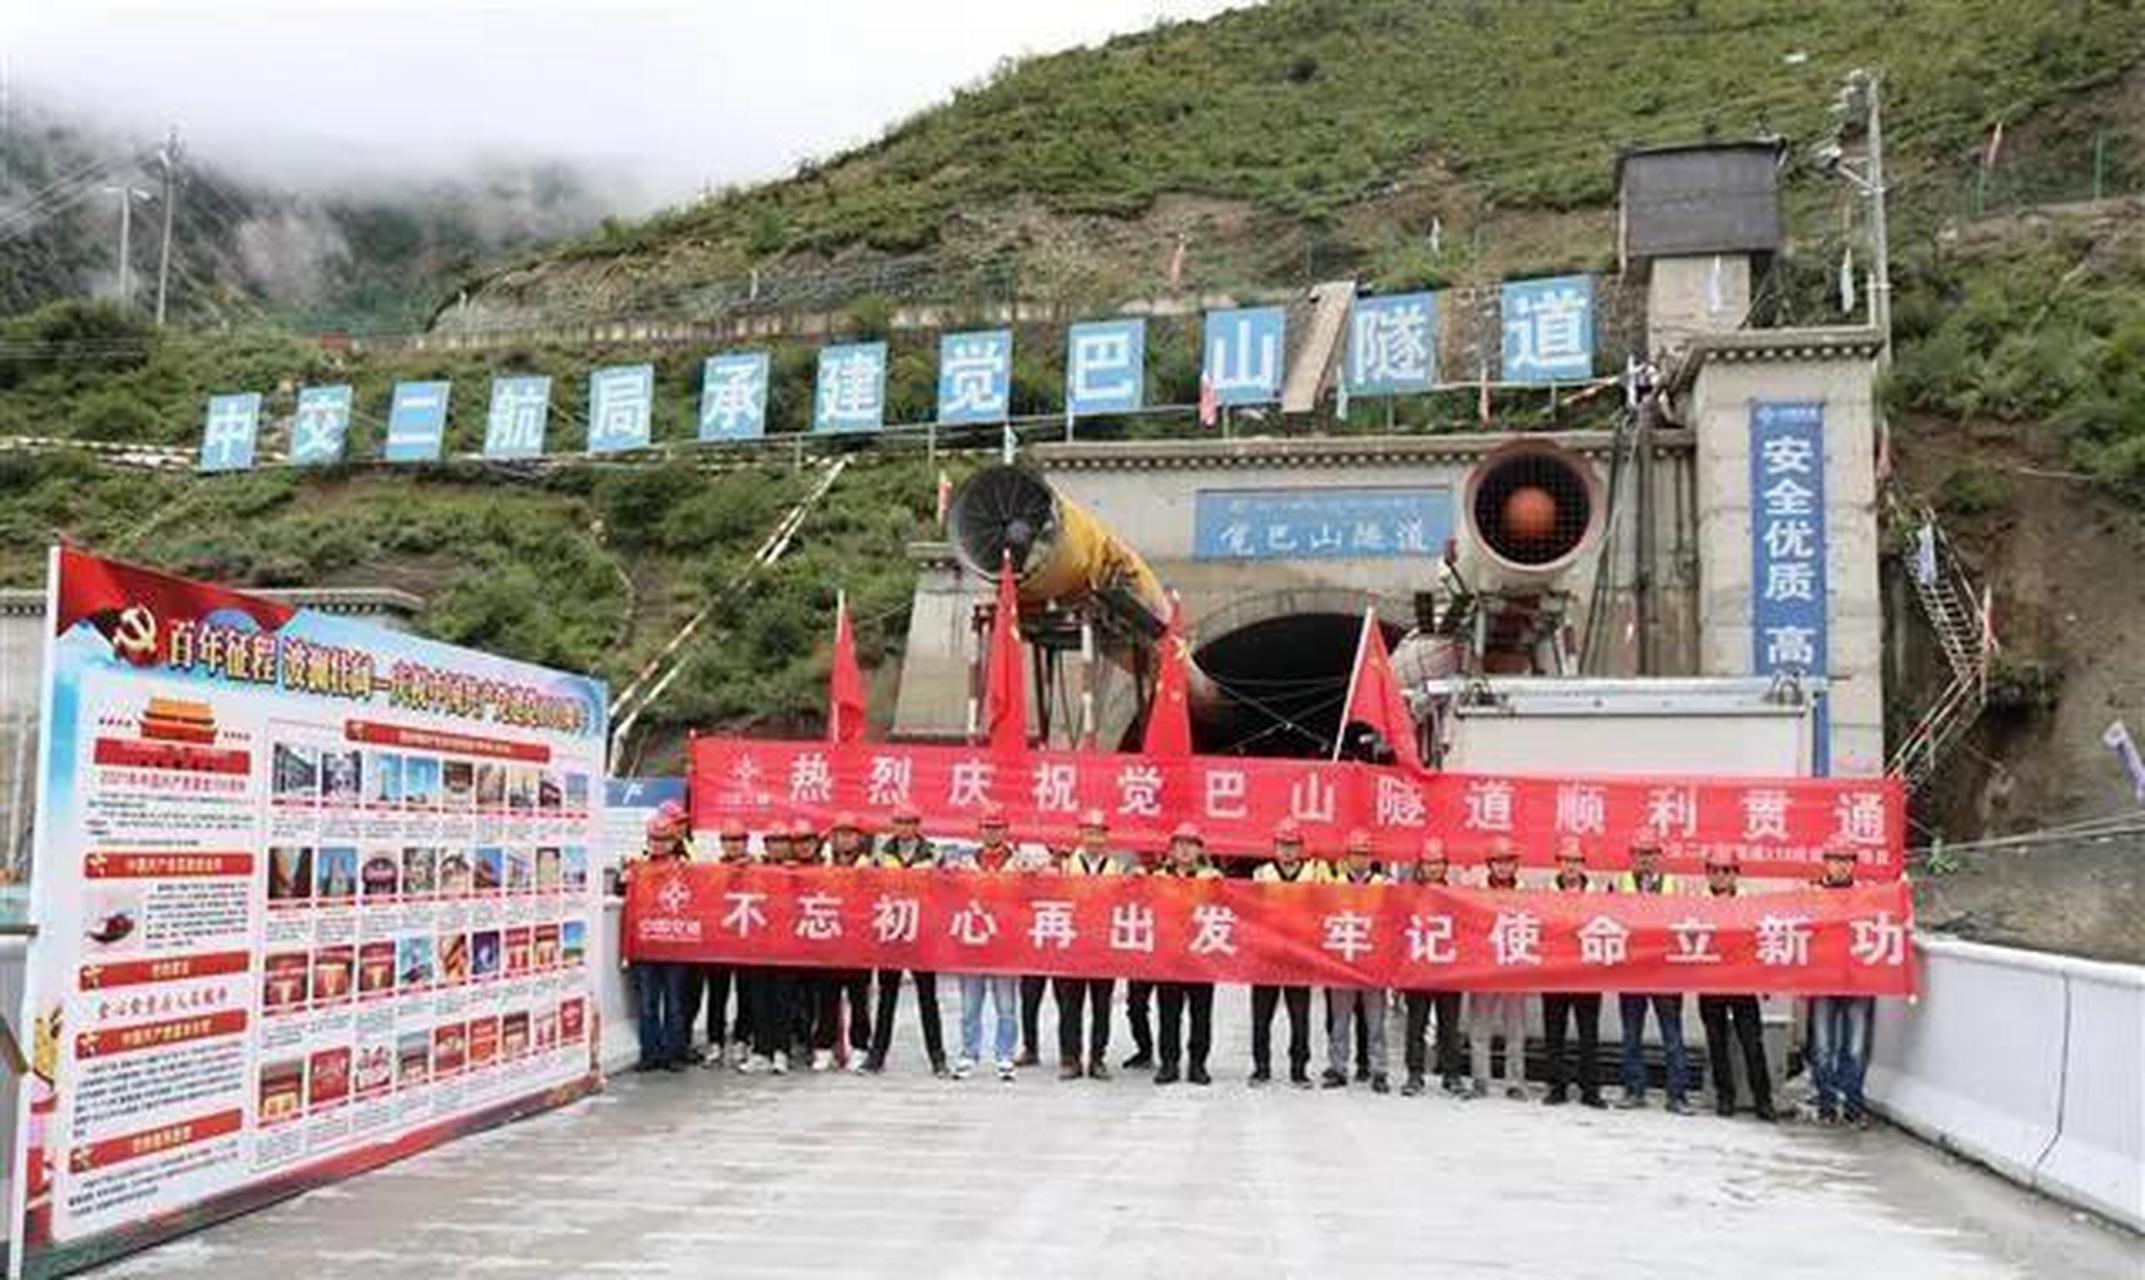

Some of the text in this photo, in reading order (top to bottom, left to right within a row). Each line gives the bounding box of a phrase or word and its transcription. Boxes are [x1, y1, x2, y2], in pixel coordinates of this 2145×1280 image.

[204, 290, 1588, 462] 中交二航局承建觉巴山隧道
[1219, 517, 1429, 556] 觉巴山隧道
[1762, 435, 1815, 600] 安全优质
[168, 618, 277, 682] 百年征程
[790, 753, 1888, 846] 热烈庆祝觉巴山隧道顺利贯通
[722, 891, 1905, 966] 不忘初心再出发 牢记使命立新功
